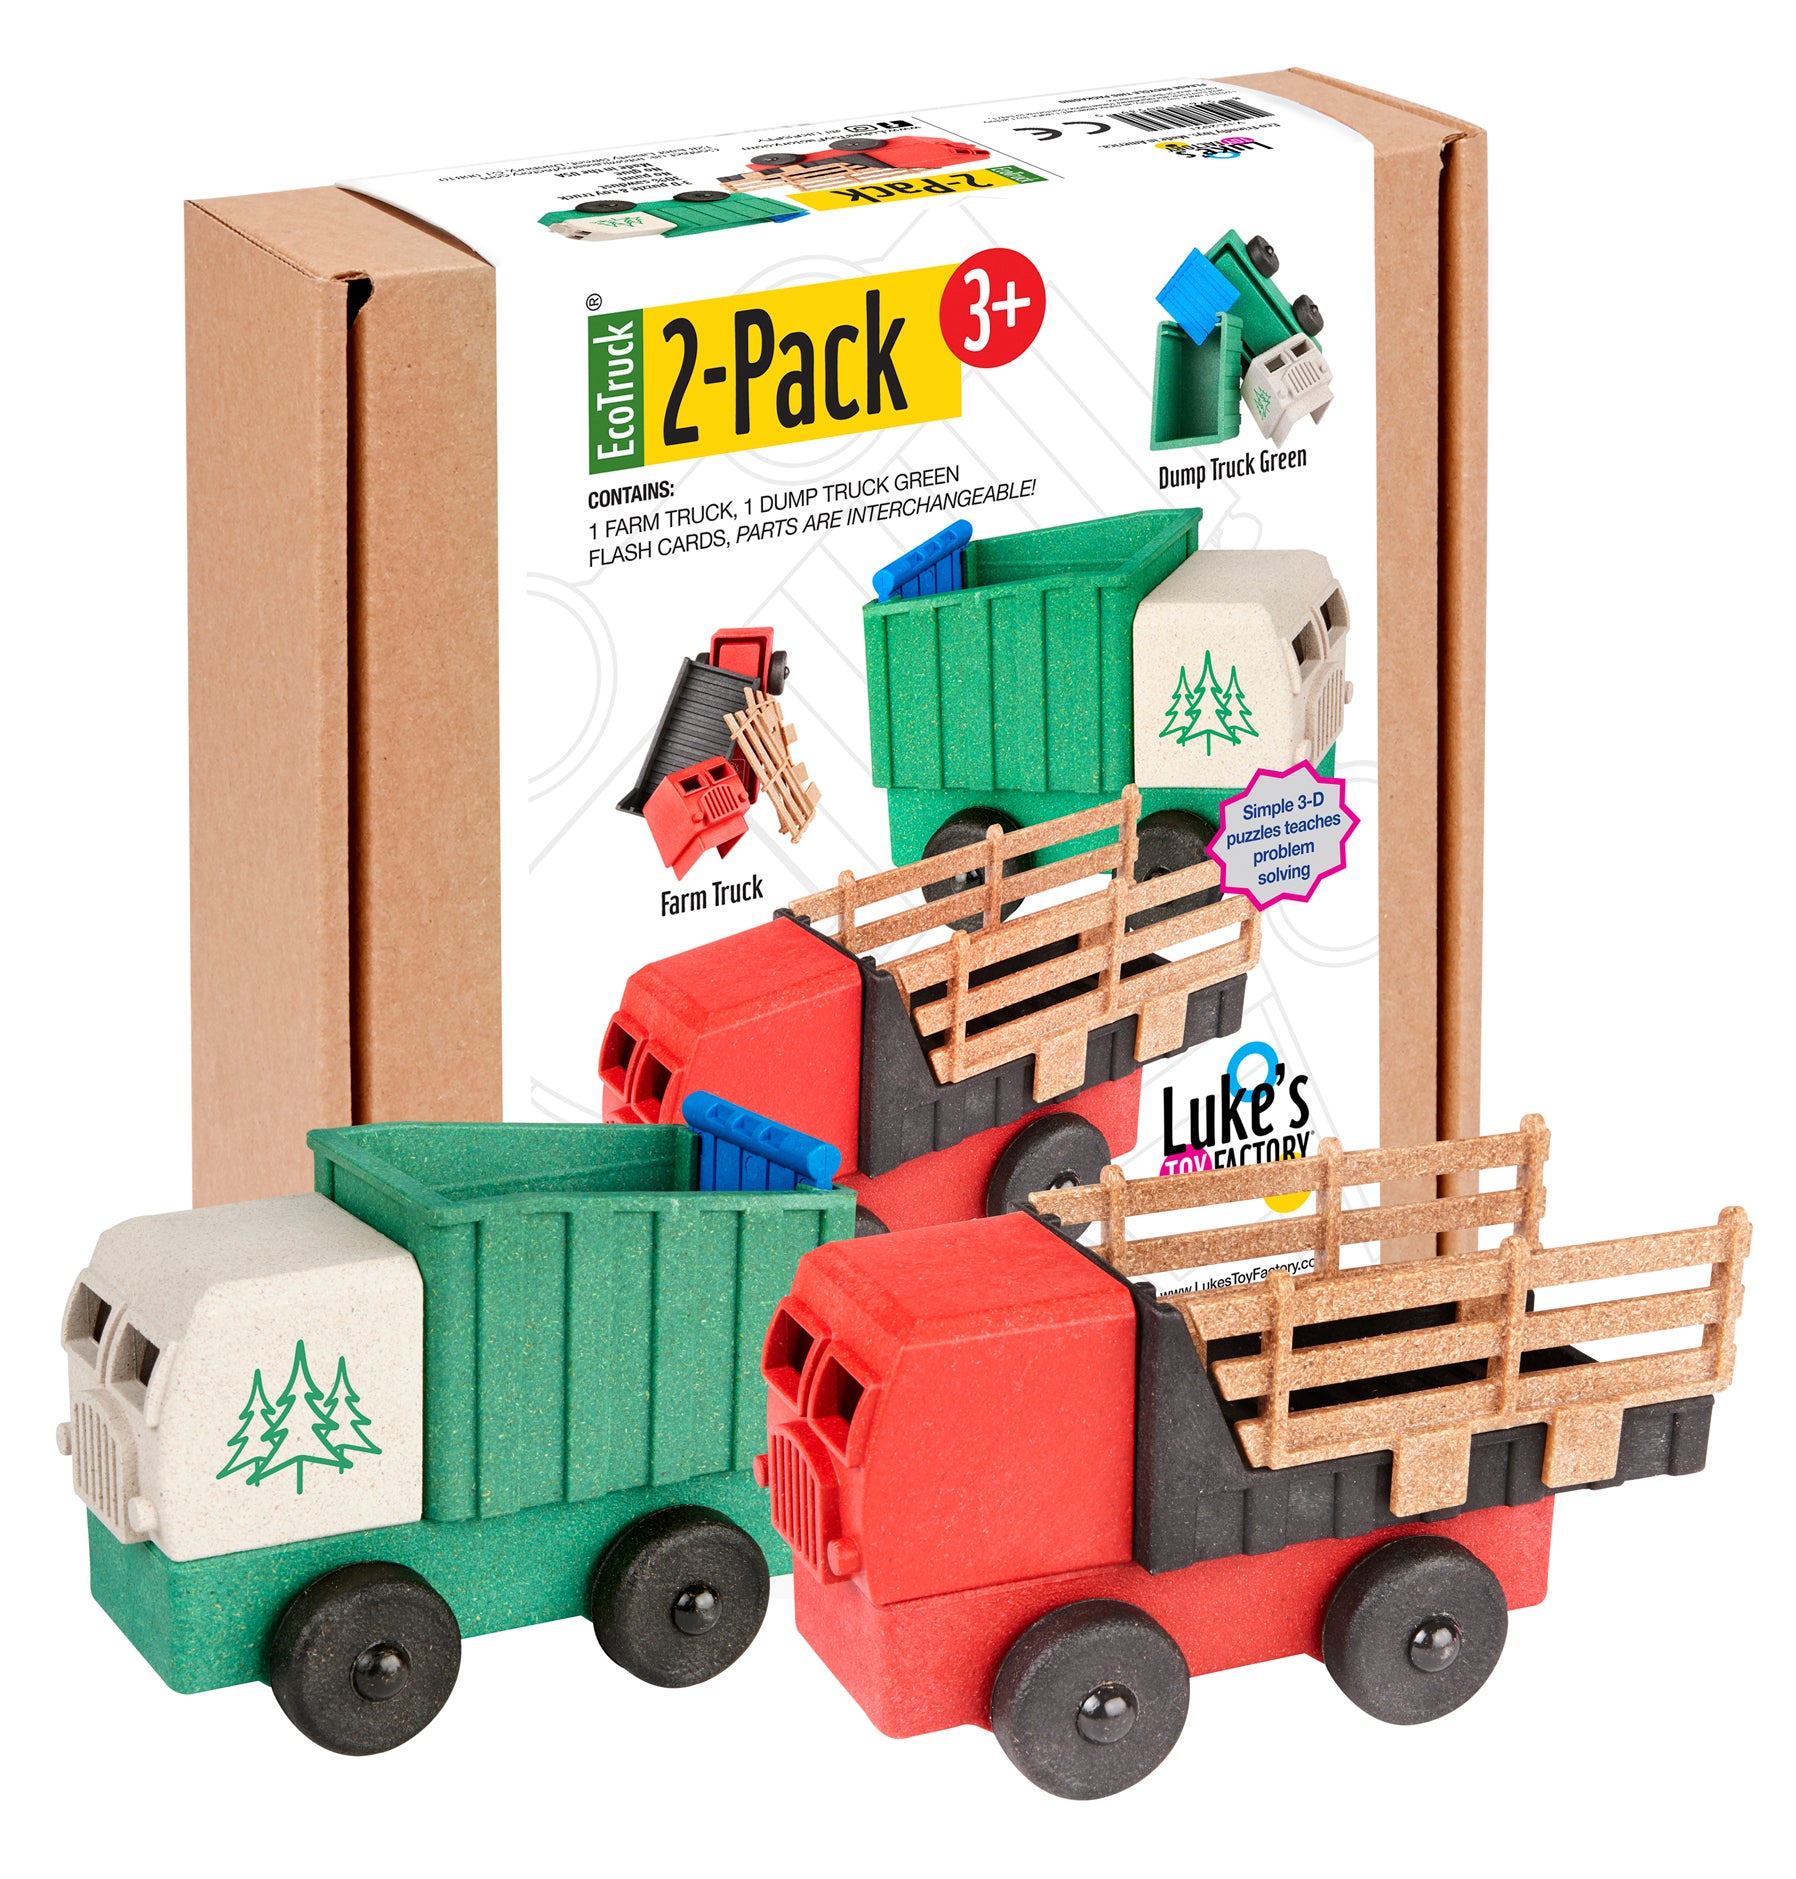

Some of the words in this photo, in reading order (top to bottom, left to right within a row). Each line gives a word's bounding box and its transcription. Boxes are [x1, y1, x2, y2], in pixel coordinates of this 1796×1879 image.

[597, 179, 651, 190] sawdust
[617, 162, 654, 171] Made
[556, 192, 596, 201] truck
[629, 181, 669, 192] puzzle
[830, 173, 994, 203] 2-Pack
[962, 267, 1032, 353] 3+
[662, 289, 908, 447] 2-Pack
[592, 320, 635, 460] EcoTruck
[1159, 465, 1206, 490] Dump
[1210, 453, 1256, 481] Truck
[1260, 448, 1307, 473] Green
[588, 480, 675, 510] CONTAINS:
[589, 522, 597, 540] 1
[605, 512, 660, 538] FARM
[664, 500, 738, 528] TRUCK,
[744, 498, 751, 516] 1
[760, 487, 818, 513] DUMP
[822, 475, 890, 503] TRUCK
[894, 464, 959, 491] GREEN
[589, 540, 652, 568] FLASH
[657, 529, 730, 556] CARDS,
[735, 517, 798, 544] PARTS
[802, 509, 844, 533] ARE
[846, 478, 1037, 526] INTERCHANGEABLE!
[1242, 798, 1294, 821] Simple
[1297, 791, 1325, 810] 3-D
[1226, 824, 1282, 850] puzzles
[1283, 813, 1341, 835] teaches
[1253, 841, 1315, 868] problem
[1258, 864, 1311, 886] solving
[661, 889, 707, 917] Farm
[711, 874, 764, 907] Truck
[1163, 1062, 1310, 1157] Luke's
[1214, 1130, 1311, 1170] FACTORY
